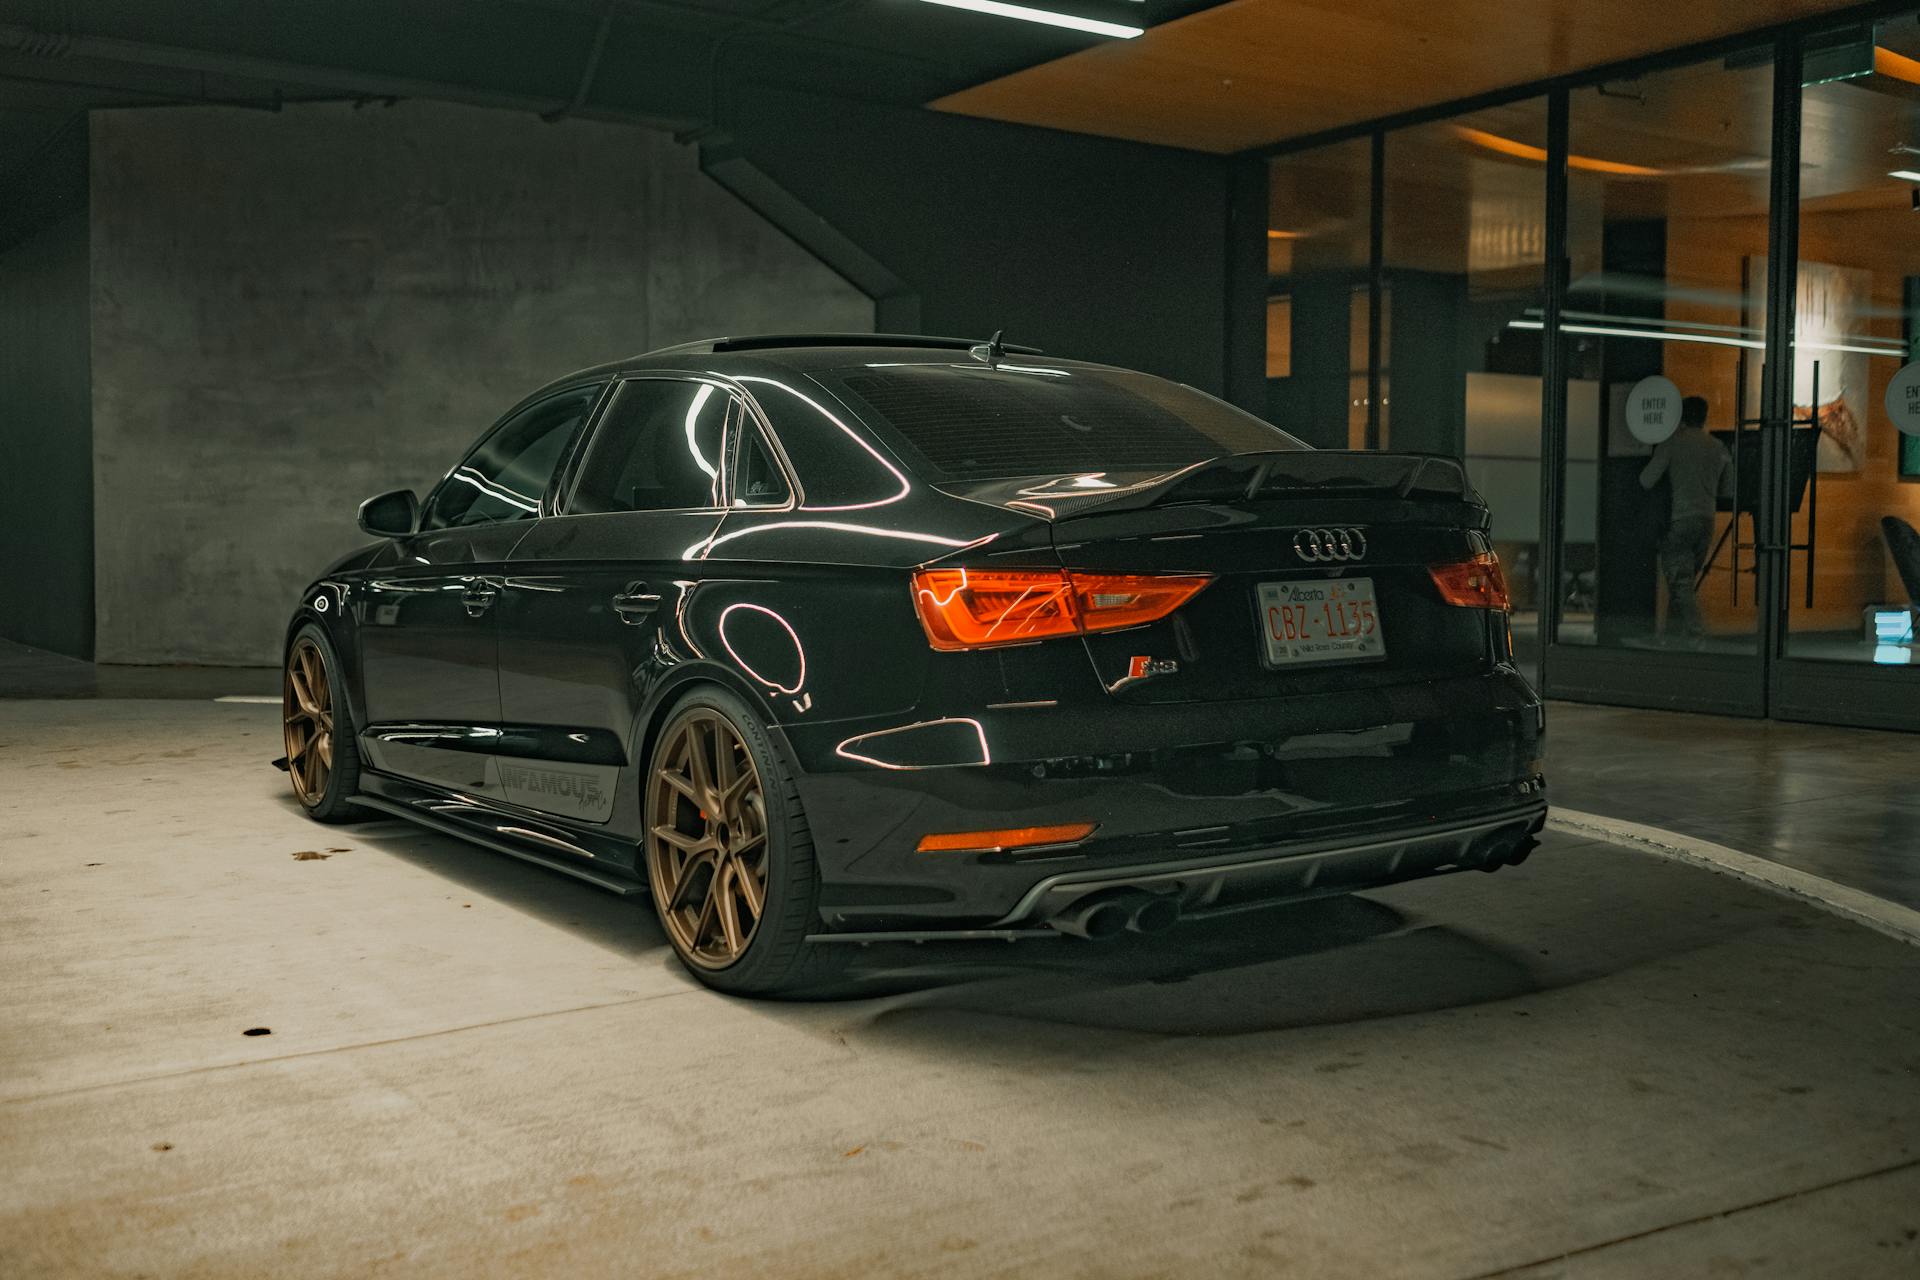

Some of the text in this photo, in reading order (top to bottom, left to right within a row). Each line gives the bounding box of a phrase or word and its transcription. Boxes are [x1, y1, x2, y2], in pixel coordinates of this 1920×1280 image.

[1641, 397, 1666, 411] ENTER
[1643, 412, 1664, 425] HERE
[1288, 585, 1325, 602] Alberta
[501, 763, 601, 800] INFAMOUS
